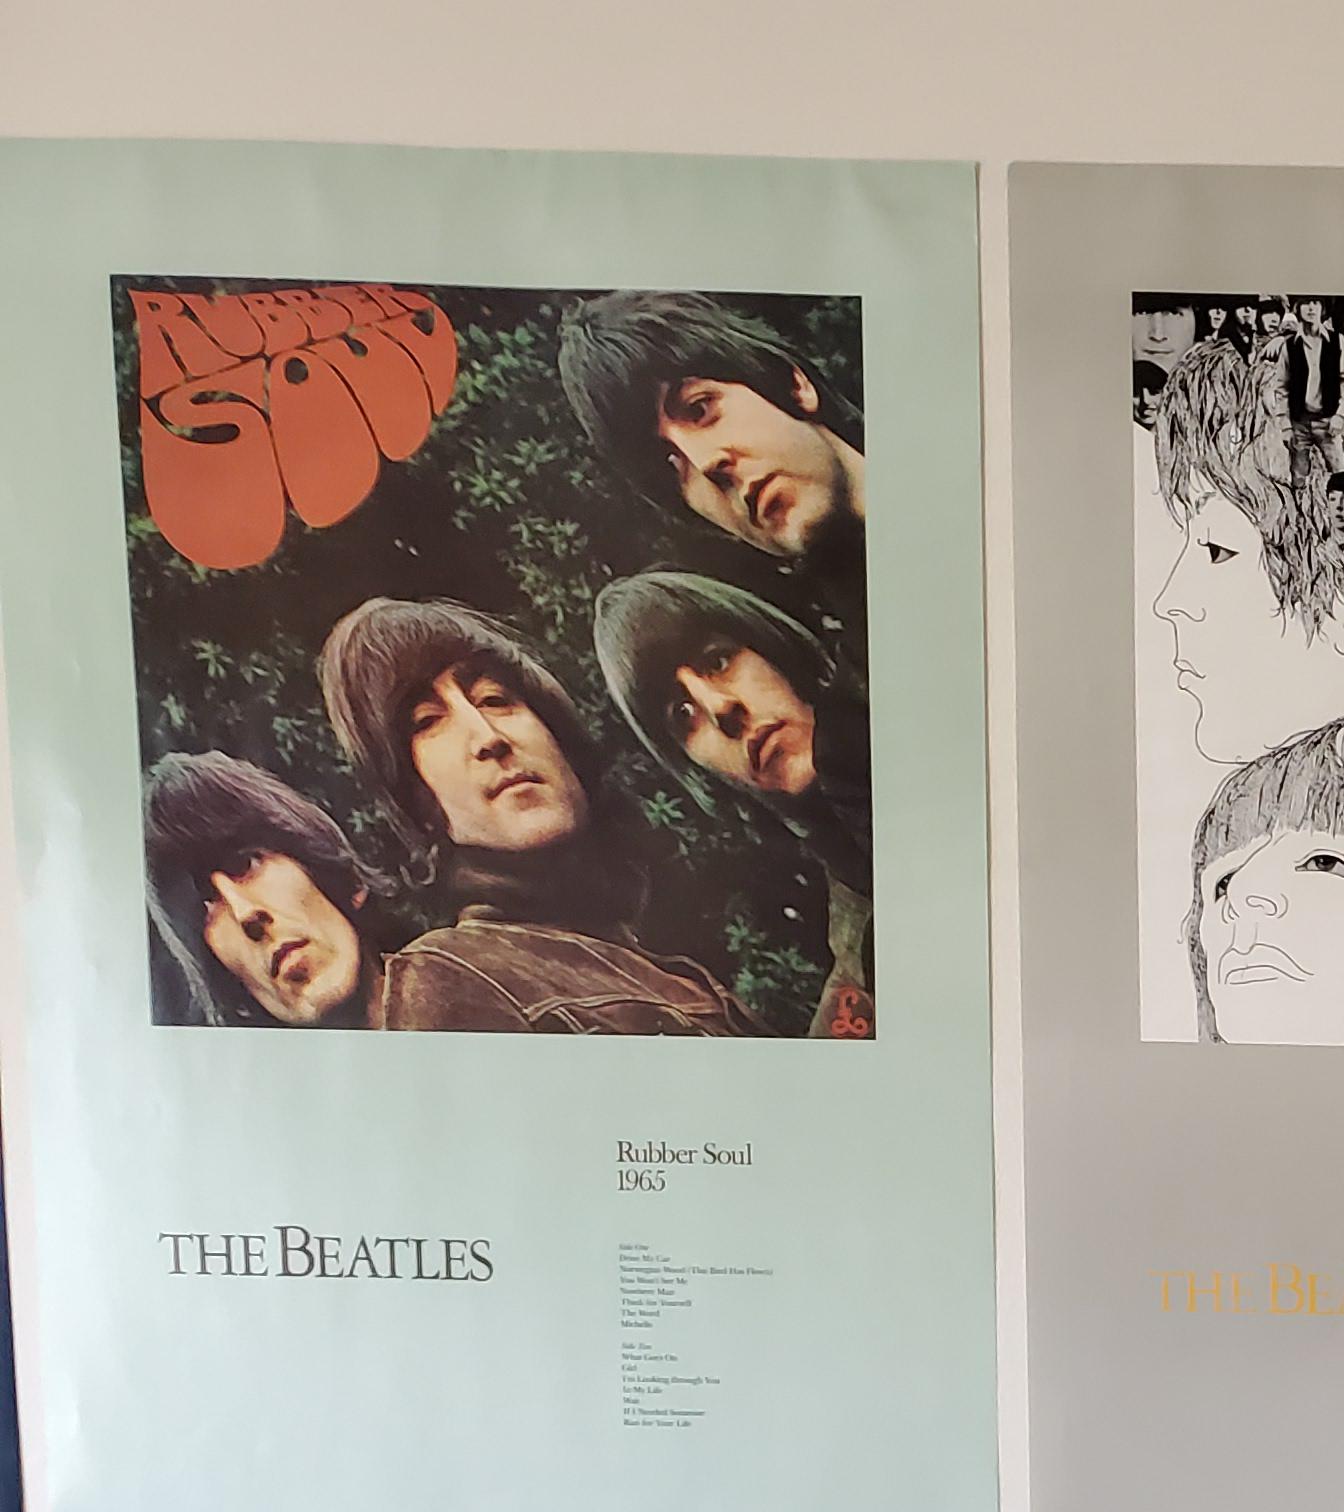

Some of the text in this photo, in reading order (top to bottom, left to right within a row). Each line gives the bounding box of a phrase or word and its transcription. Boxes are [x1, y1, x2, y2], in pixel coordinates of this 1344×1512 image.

[130, 284, 432, 381] RUBBER
[140, 304, 457, 569] SOUL
[616, 1140, 752, 1166] Rubber Soul
[616, 1169, 666, 1191] 1965
[159, 1225, 494, 1283] THE BEATLES
[1149, 1269, 1257, 1315] THE
